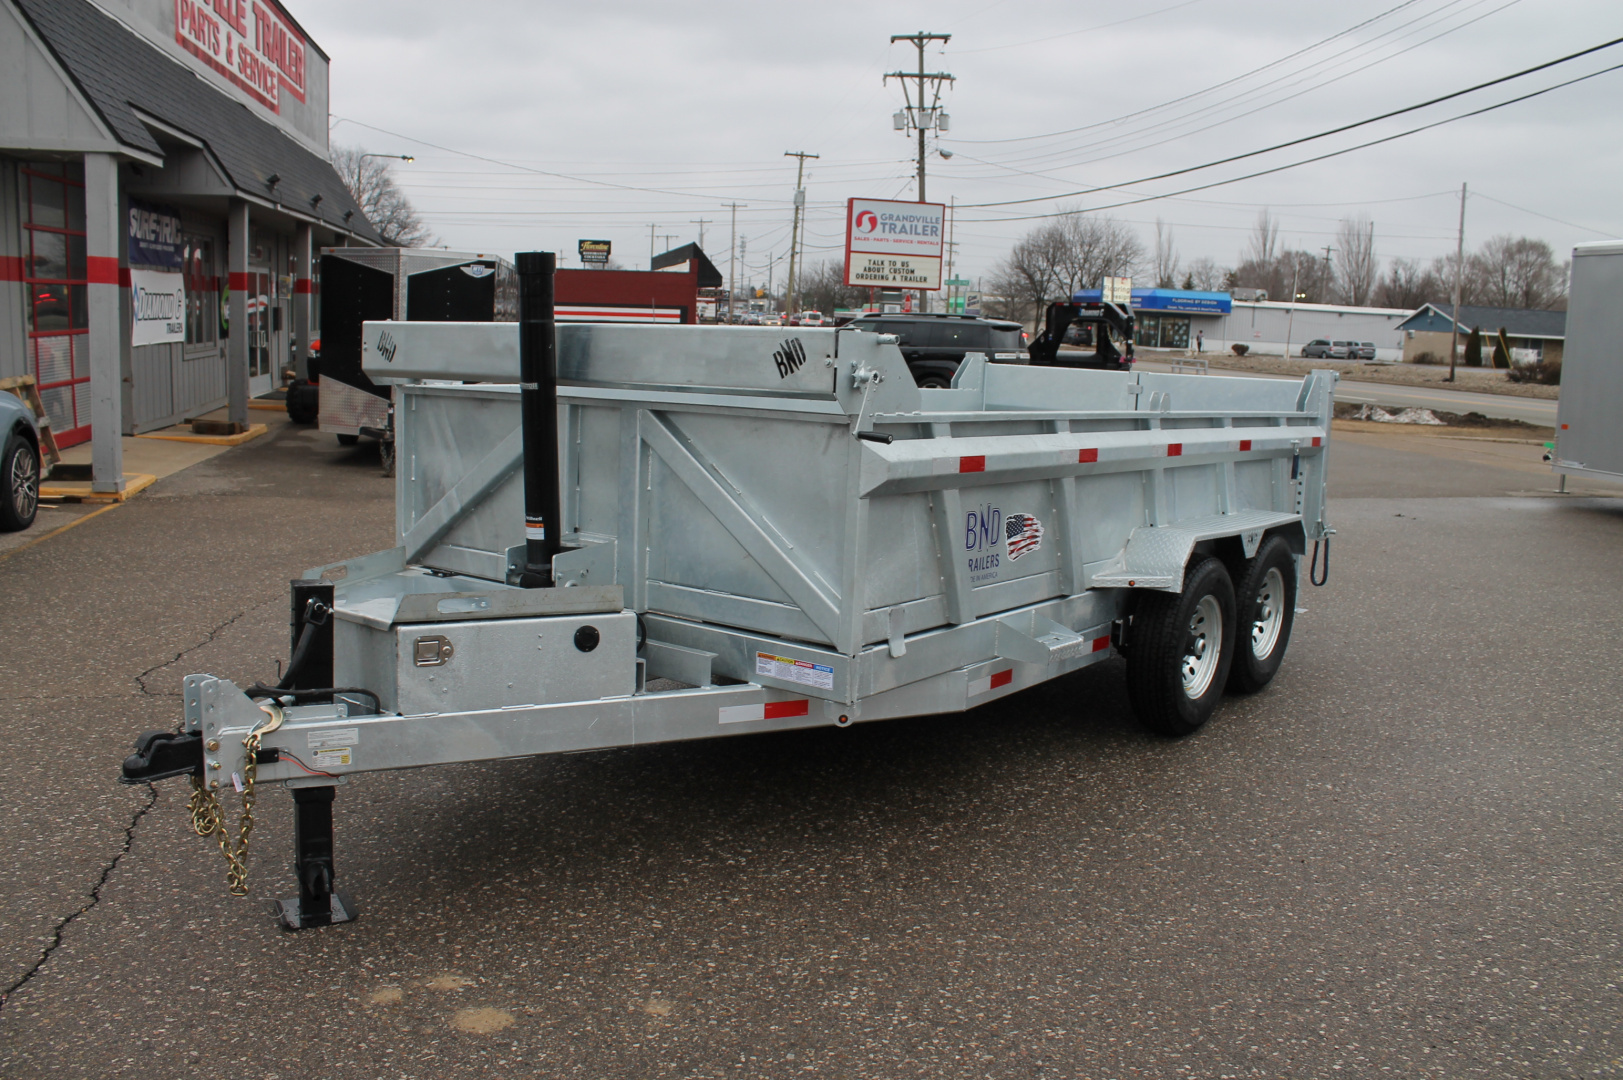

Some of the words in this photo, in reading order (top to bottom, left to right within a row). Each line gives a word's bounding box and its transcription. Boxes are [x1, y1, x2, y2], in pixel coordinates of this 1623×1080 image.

[181, 1, 221, 56] PARTS
[226, 31, 234, 66] &
[238, 42, 277, 100] SERVICE
[253, 1, 304, 89] TRAILER
[880, 213, 940, 224] GRANDVILLE
[880, 222, 939, 237] TRAILER
[855, 272, 889, 281] ORDERING
[900, 275, 928, 283] TRAILER
[889, 267, 915, 275] CUSTOM
[174, 288, 182, 319] C
[166, 322, 183, 335] TRAILERS
[772, 337, 806, 379] BND
[965, 503, 1001, 552] BND
[968, 553, 1000, 572] RAILERS
[981, 571, 998, 580] AMERICA
